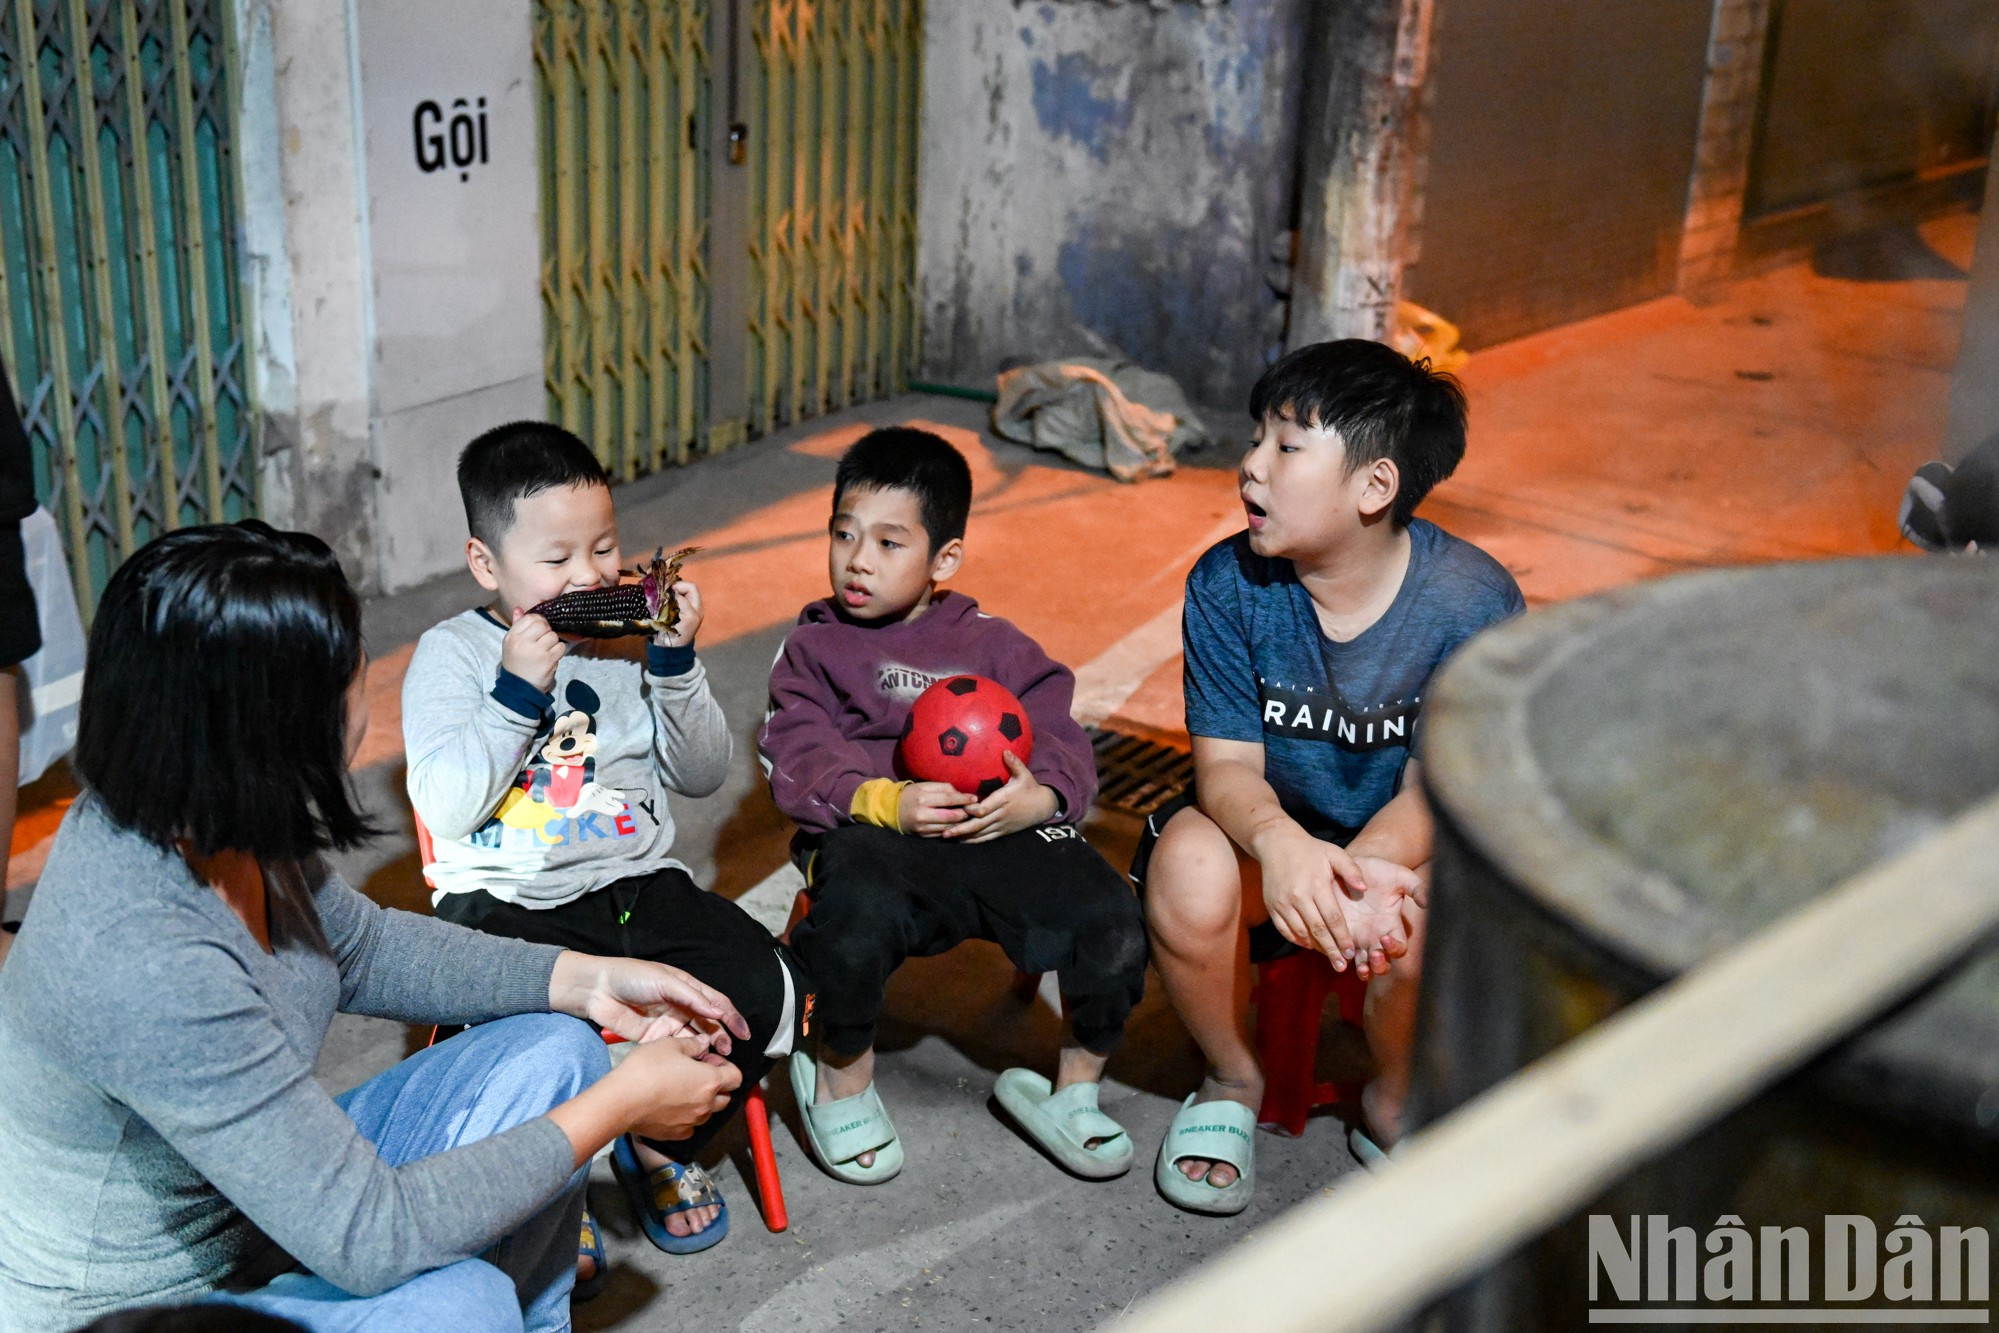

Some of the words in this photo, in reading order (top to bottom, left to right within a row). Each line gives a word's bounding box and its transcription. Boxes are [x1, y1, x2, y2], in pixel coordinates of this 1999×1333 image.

[414, 97, 488, 182] Gội
[1252, 671, 1314, 693] RAIN
[1263, 699, 1419, 744] RAININ
[1035, 825, 1088, 843] 197
[1179, 1125, 1226, 1136] SNEAKER
[1228, 1125, 1251, 1146] BUZ
